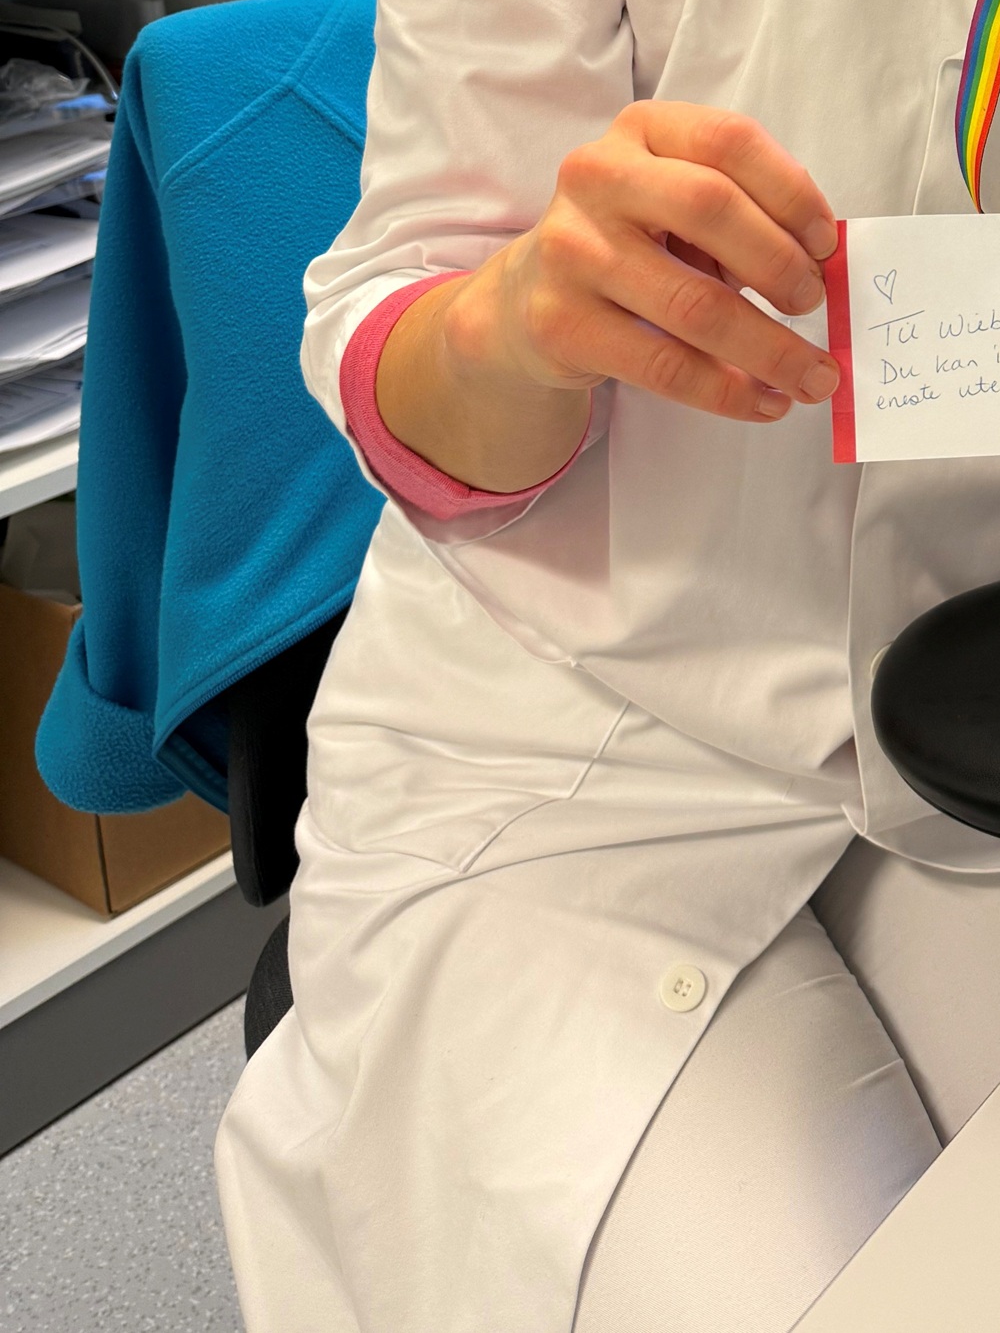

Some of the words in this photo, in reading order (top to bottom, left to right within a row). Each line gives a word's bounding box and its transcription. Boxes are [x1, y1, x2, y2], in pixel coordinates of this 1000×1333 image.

[868, 310, 925, 346] Til
[879, 358, 920, 385] Du
[936, 354, 978, 374] kan
[876, 384, 941, 410] eneste
